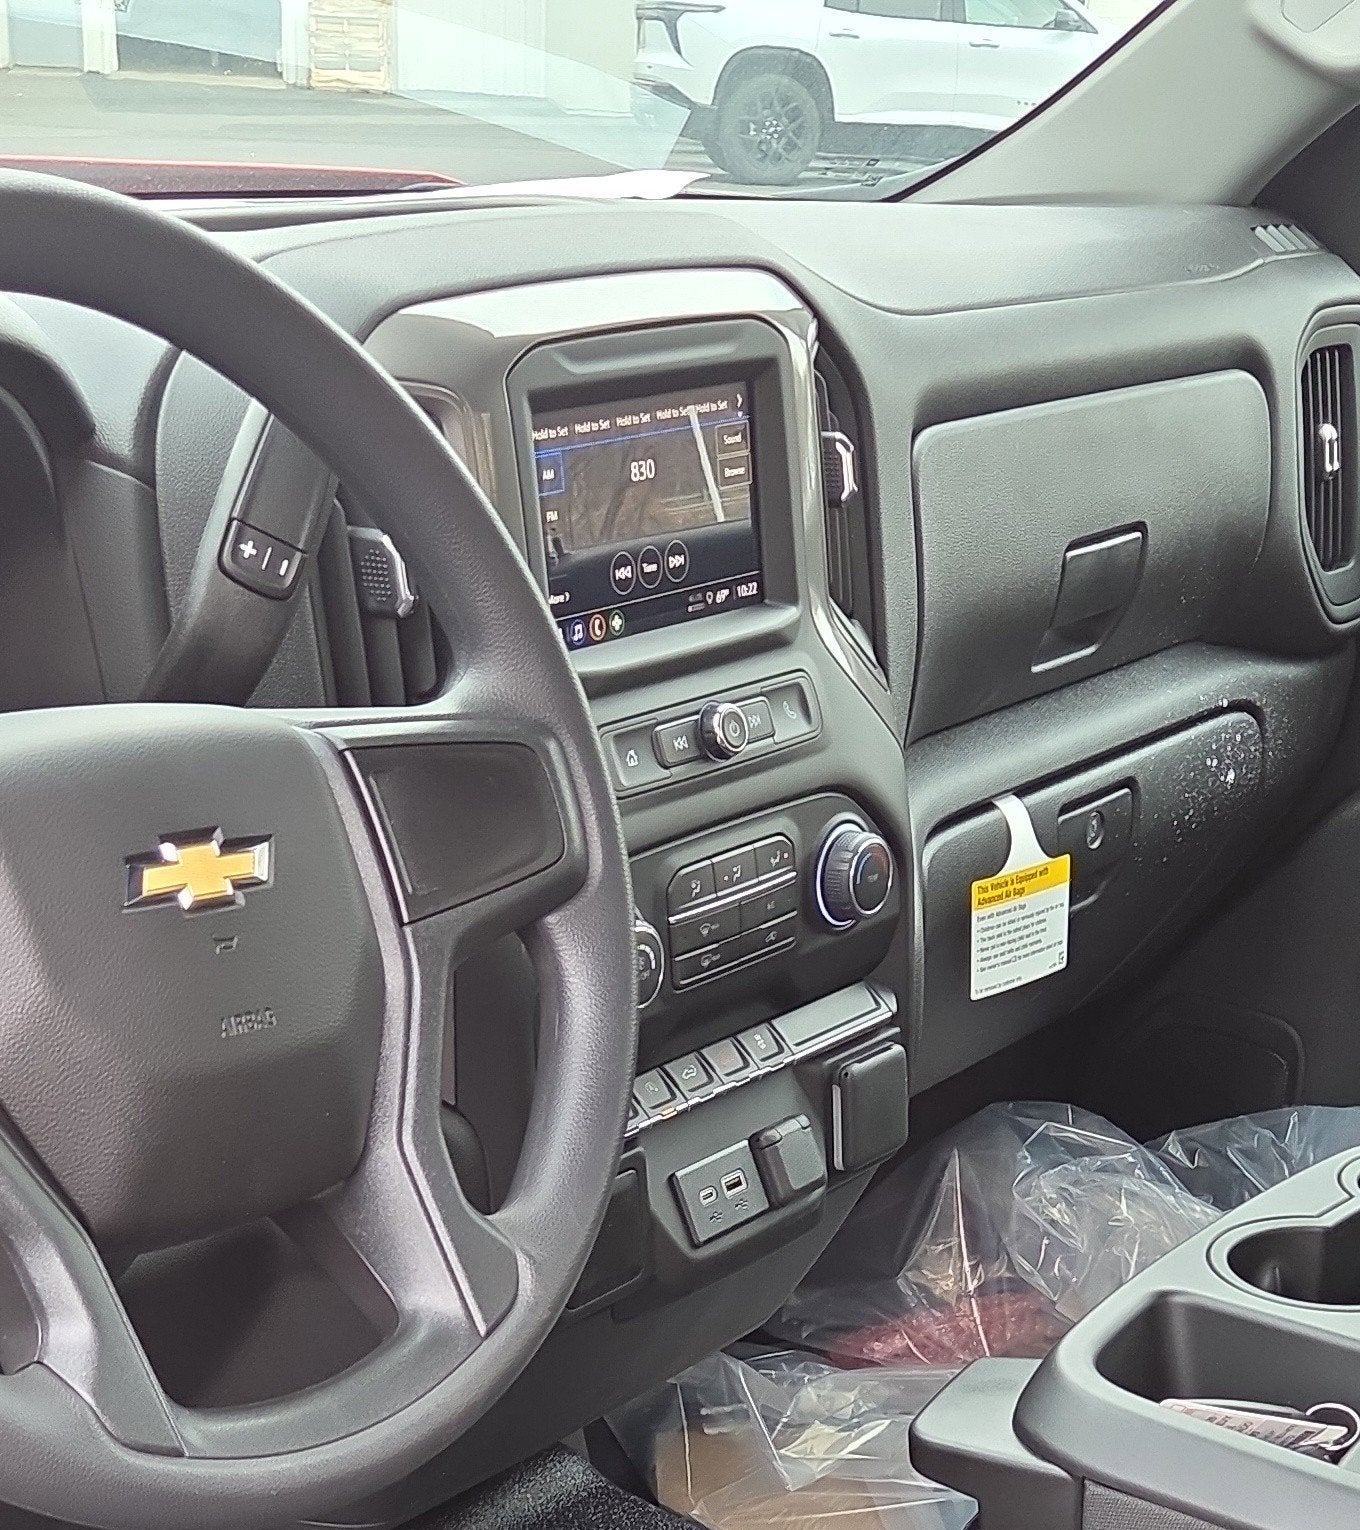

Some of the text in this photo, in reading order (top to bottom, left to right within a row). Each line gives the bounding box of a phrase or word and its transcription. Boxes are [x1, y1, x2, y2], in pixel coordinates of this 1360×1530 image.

[640, 412, 651, 423] Set
[599, 419, 610, 430] Set
[557, 426, 568, 438] Set
[542, 469, 555, 481] AM
[630, 458, 655, 482] 830
[546, 511, 559, 523] FM
[736, 581, 758, 597] 10:22
